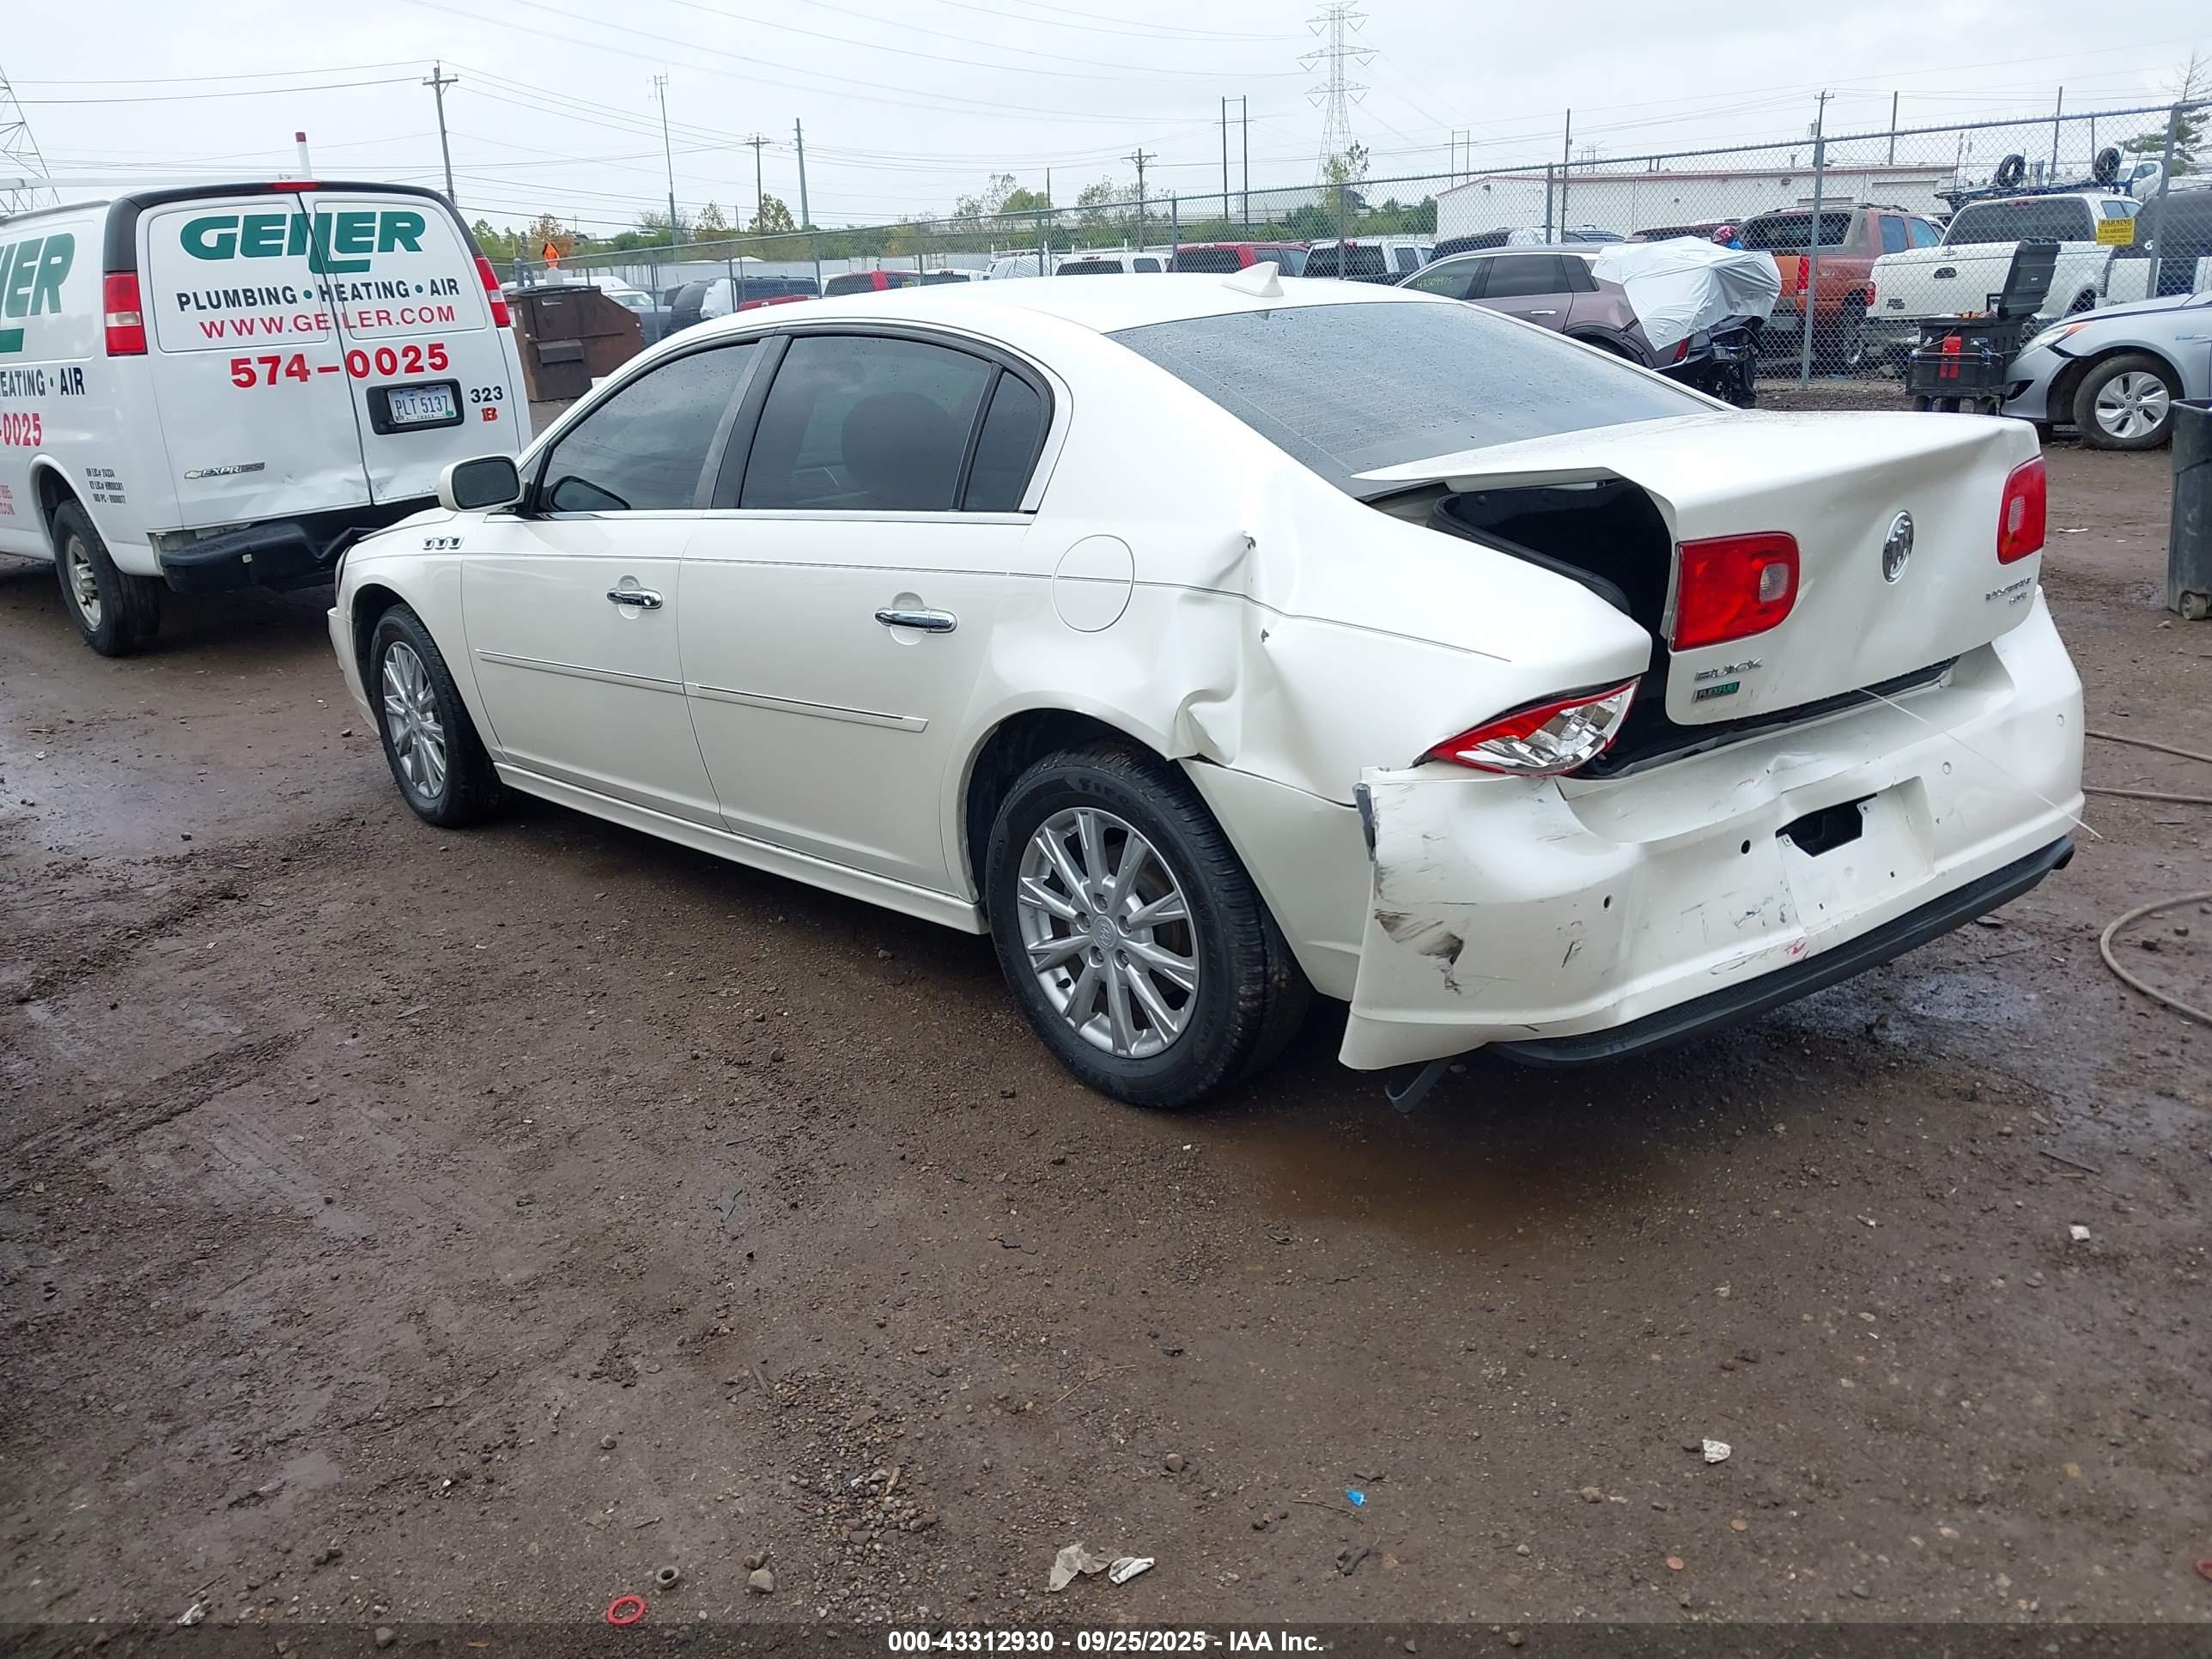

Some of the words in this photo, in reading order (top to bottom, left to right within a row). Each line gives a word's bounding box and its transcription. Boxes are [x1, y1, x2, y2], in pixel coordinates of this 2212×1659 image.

[179, 211, 426, 275] GEILER
[176, 285, 298, 312] PLUMBING
[318, 280, 410, 302] HEATING
[429, 277, 460, 297] AIR
[199, 305, 456, 339] WWW.GEILER.COM
[0, 369, 46, 397] EATING
[60, 367, 85, 396] AIR
[230, 343, 449, 388] 574-0025
[394, 398, 417, 416] PLT
[420, 395, 449, 414] 5137
[470, 386, 503, 404] 323
